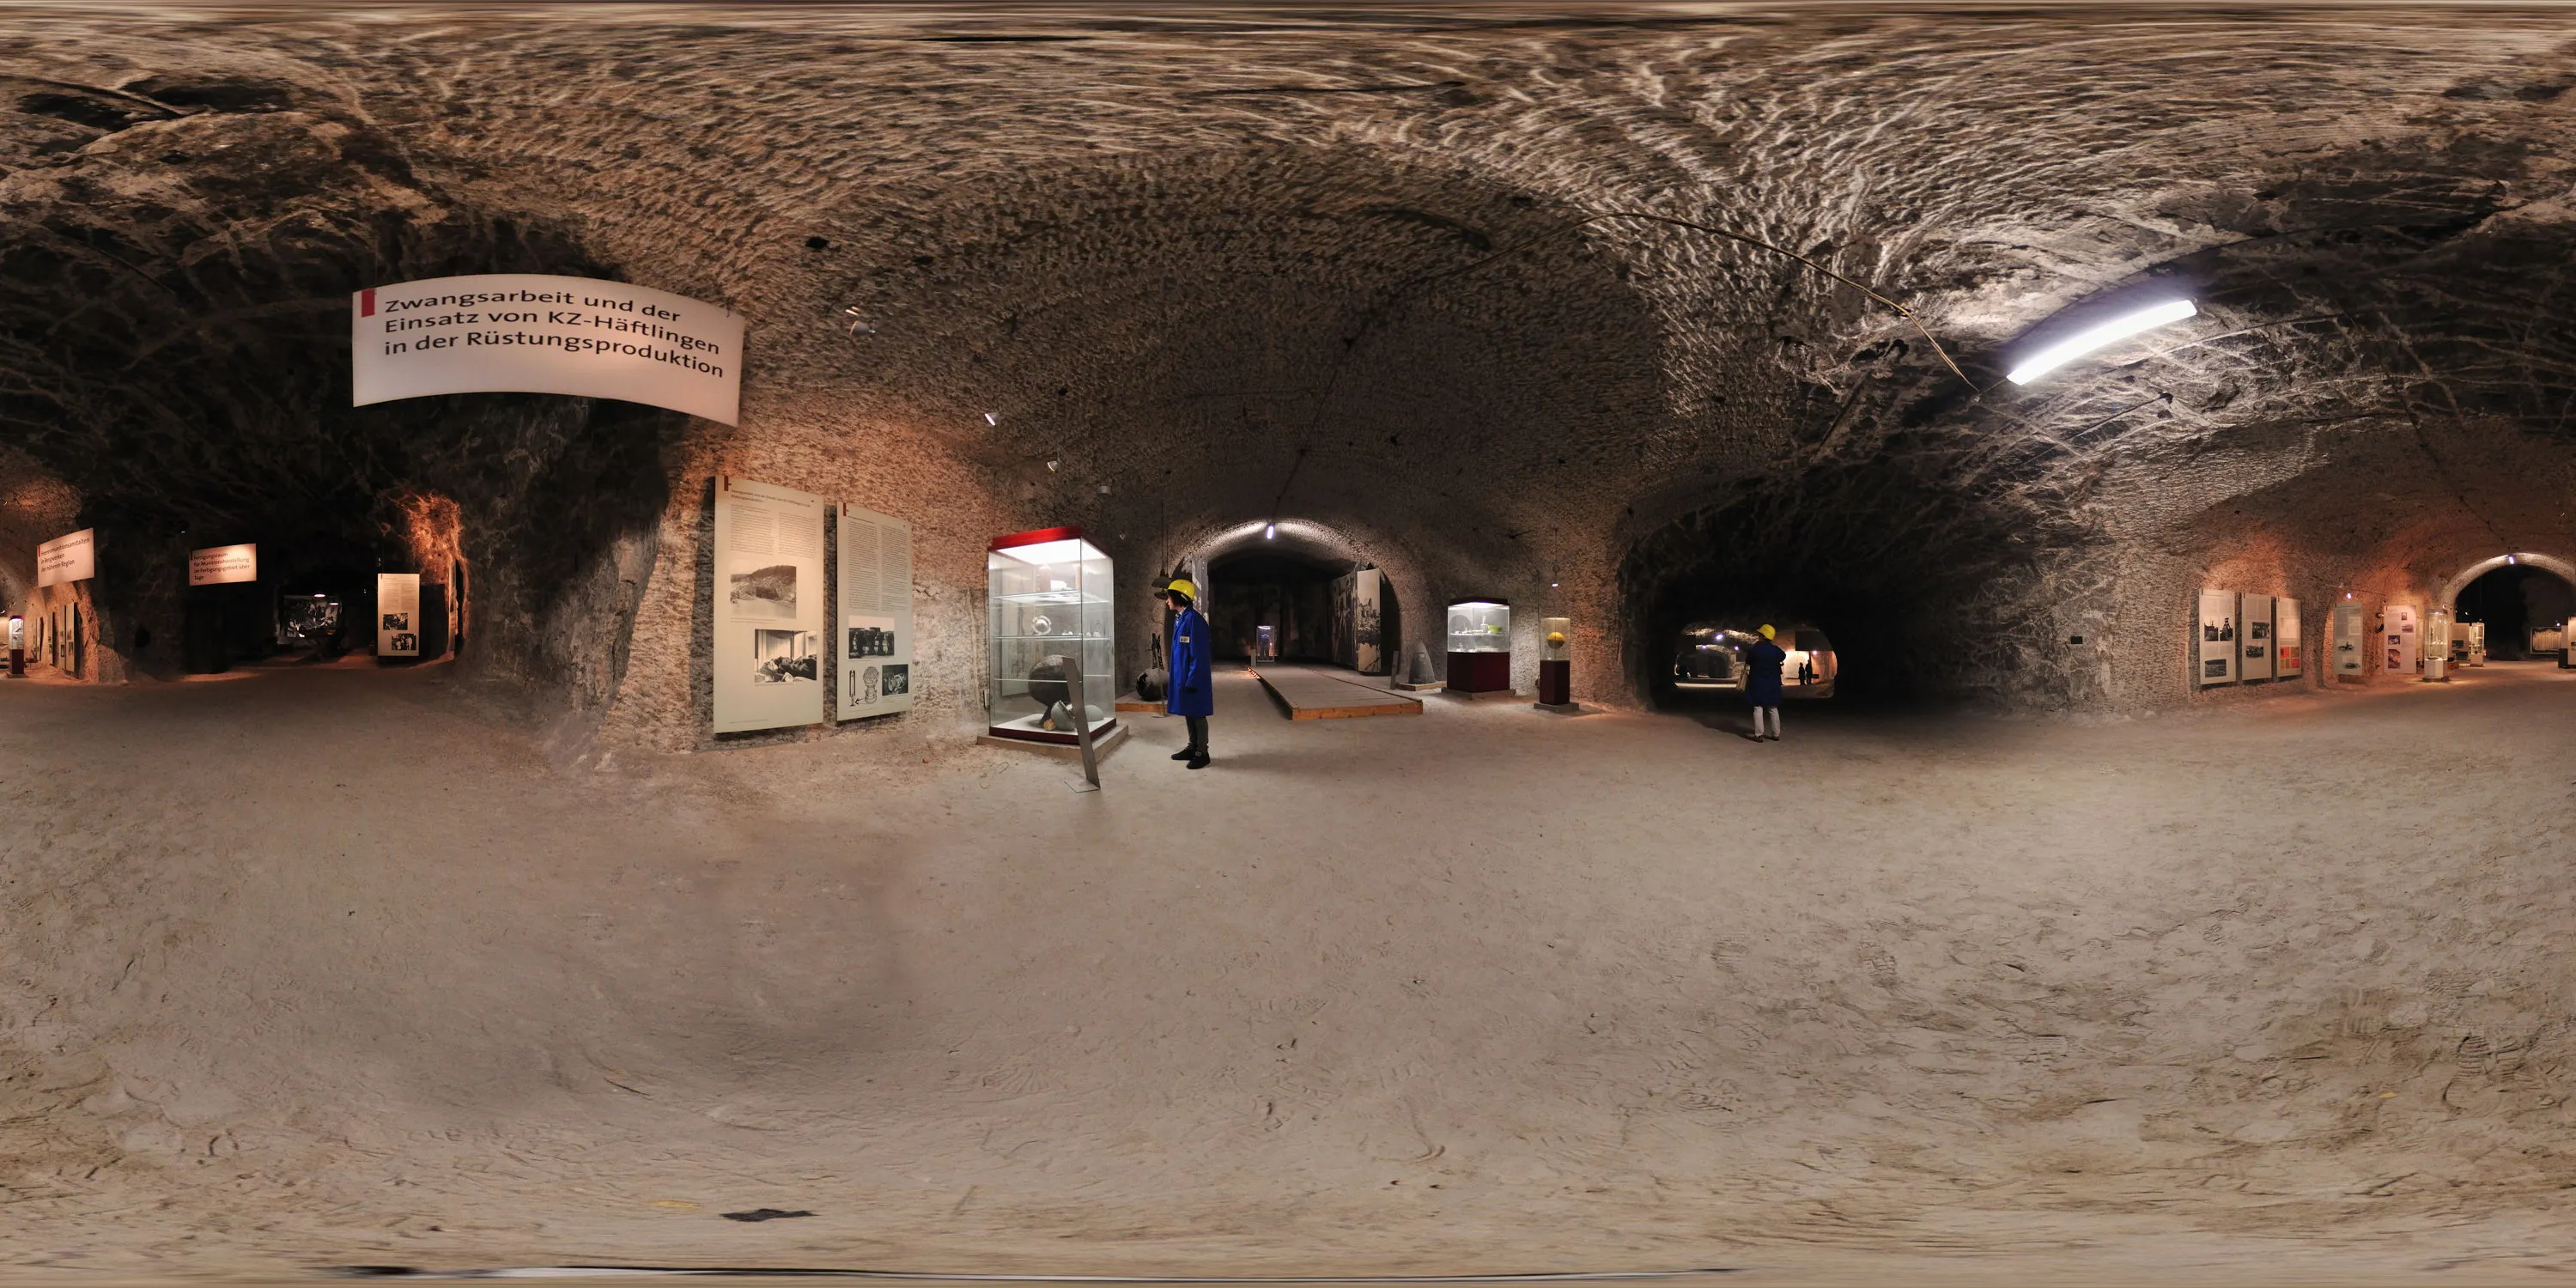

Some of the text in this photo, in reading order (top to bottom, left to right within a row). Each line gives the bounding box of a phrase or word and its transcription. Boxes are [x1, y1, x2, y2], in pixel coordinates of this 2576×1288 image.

[385, 289, 681, 322] Zwangsarbeit und der
[385, 311, 720, 355] Einsatz von KZ-Häftlingen
[385, 331, 724, 378] in der Rüstungsproduktion
